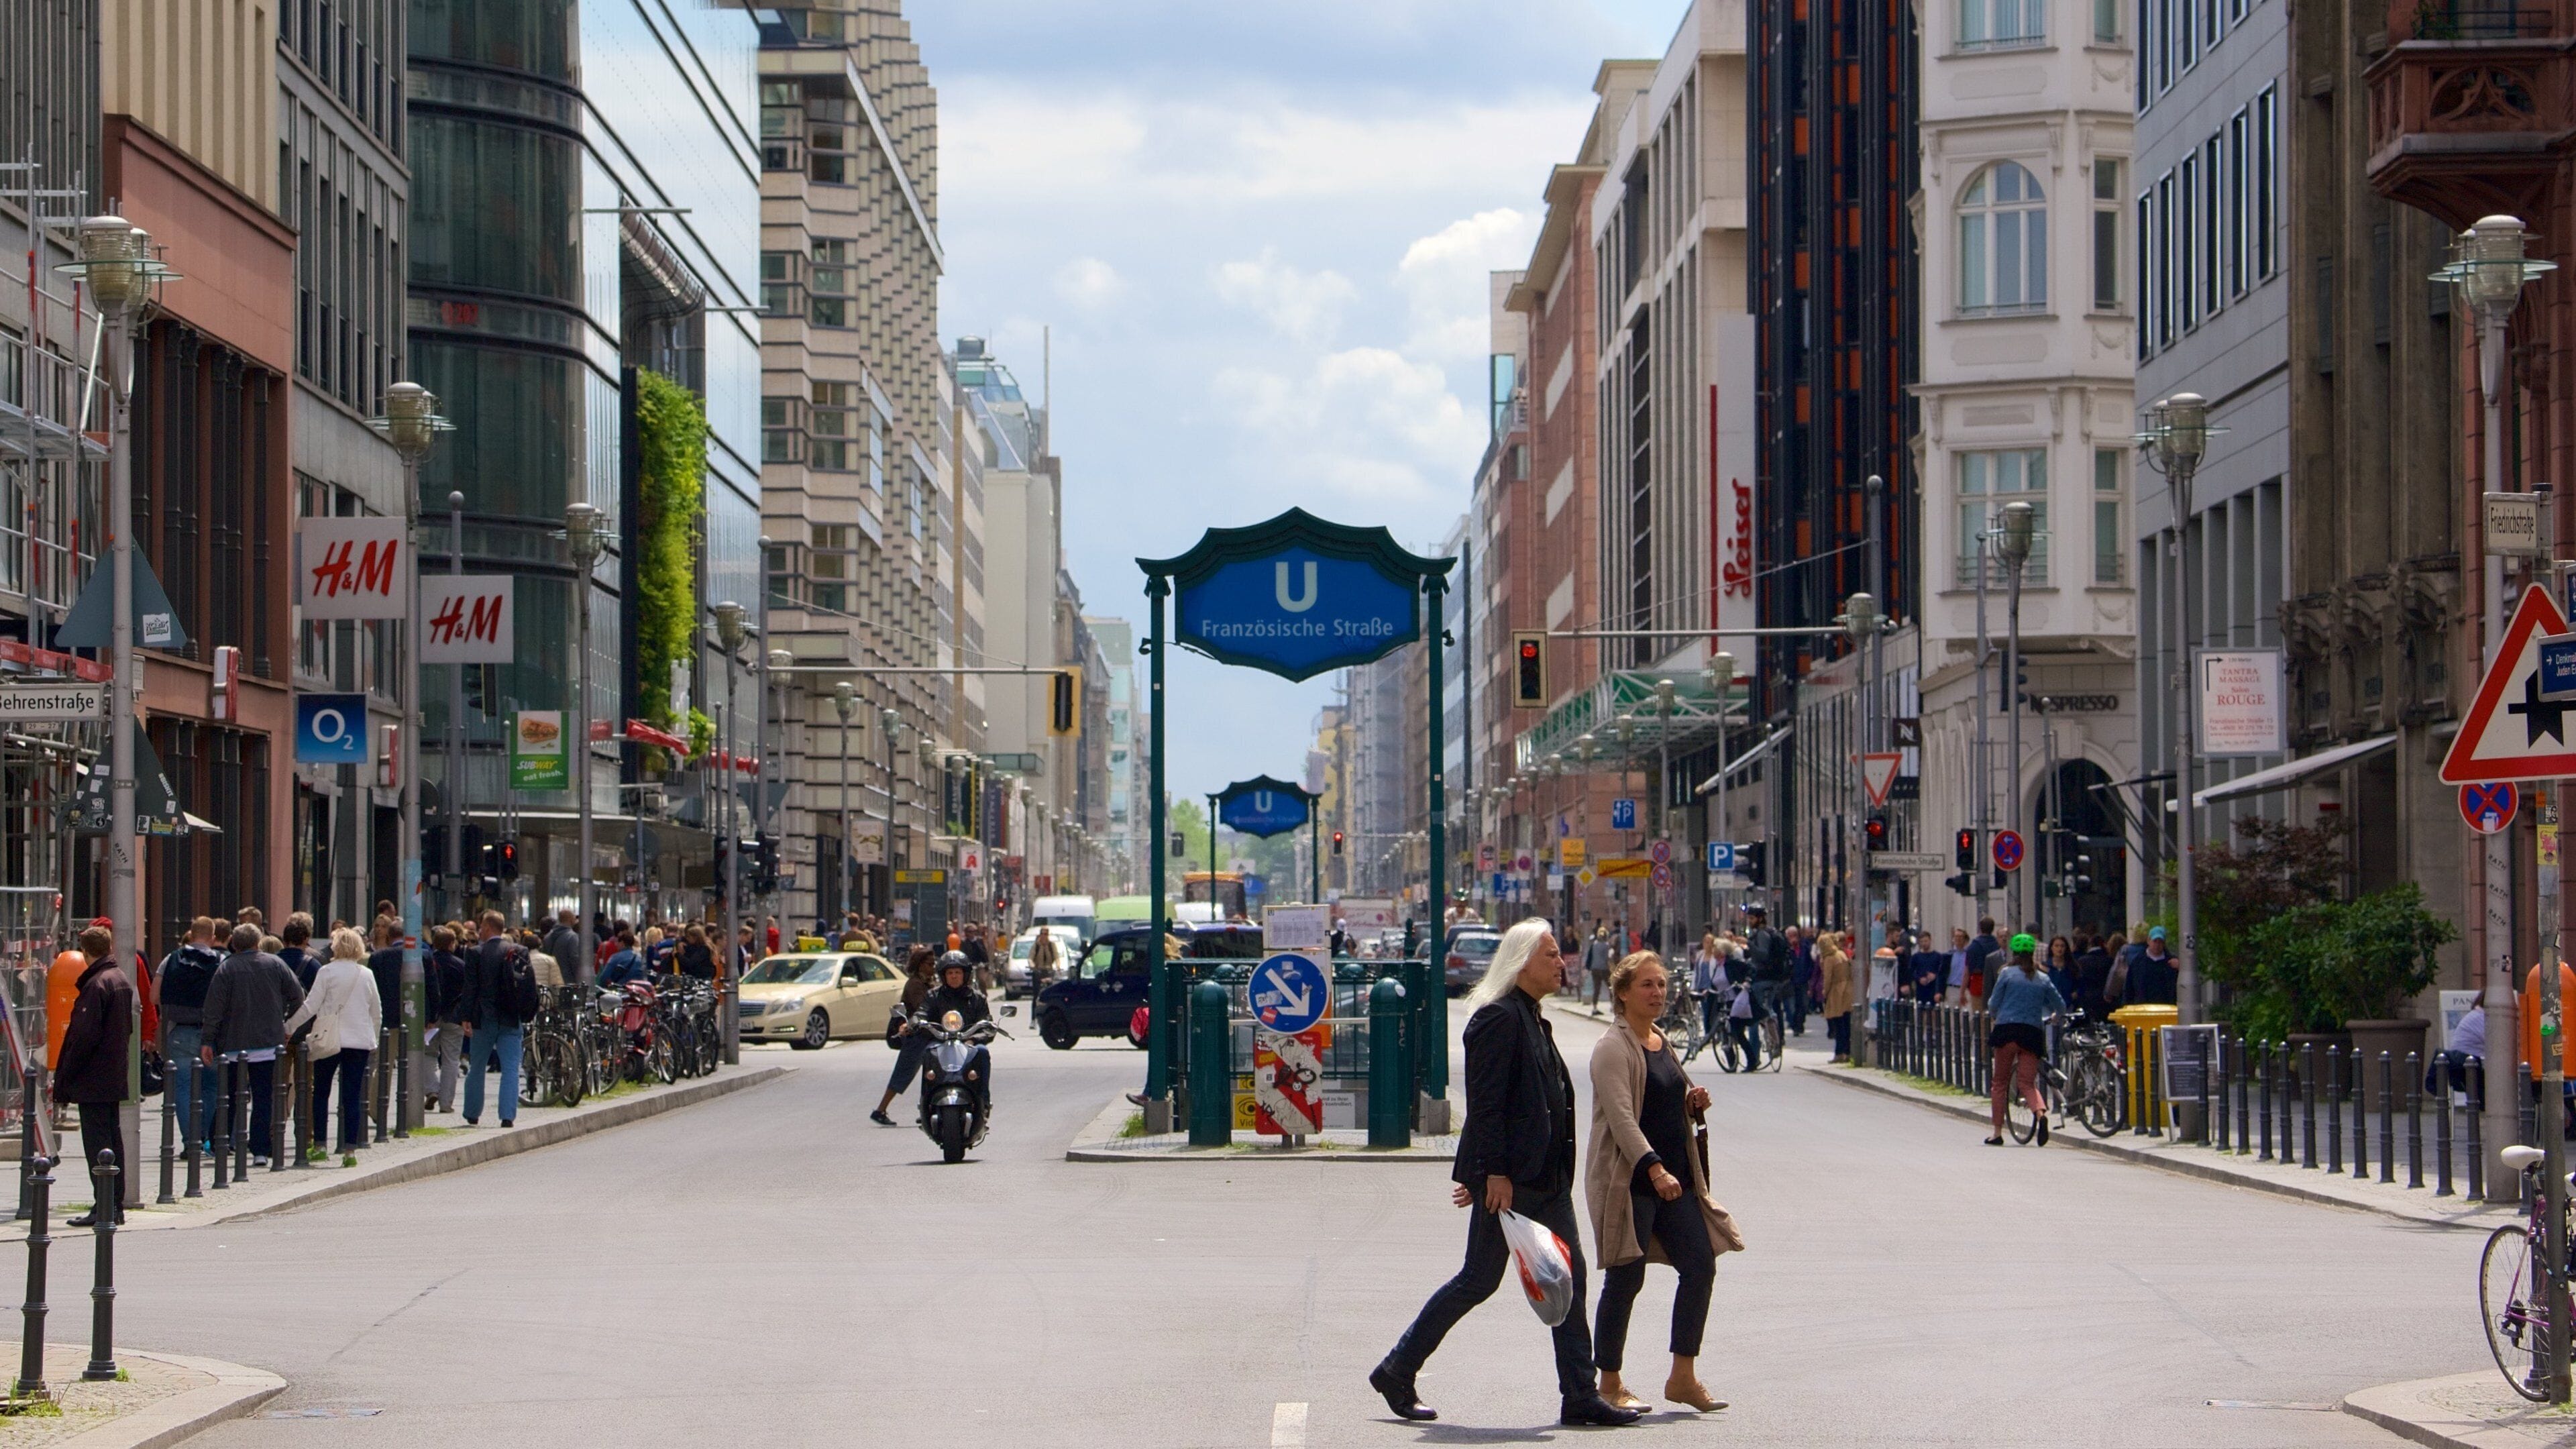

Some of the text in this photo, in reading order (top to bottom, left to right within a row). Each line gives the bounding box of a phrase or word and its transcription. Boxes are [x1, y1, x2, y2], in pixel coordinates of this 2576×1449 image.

[2490, 506, 2534, 541] Friedrichstraße
[1723, 478, 1751, 598] Leiser
[312, 539, 398, 597] H&M
[1275, 561, 1318, 612] U
[429, 594, 503, 645] H&M
[1201, 619, 1393, 637] Französische Straße
[0, 692, 94, 713] ehrenstraße
[2030, 694, 2119, 714] NSPRESSO
[2217, 694, 2265, 705] ROUGE
[517, 760, 559, 770] SUBWAY
[523, 773, 537, 782] eat
[1254, 791, 1273, 813] U
[1713, 845, 1728, 867] P
[2487, 853, 2506, 871] RATH
[2489, 883, 2508, 898] RATH
[2487, 908, 2506, 926] RATH
